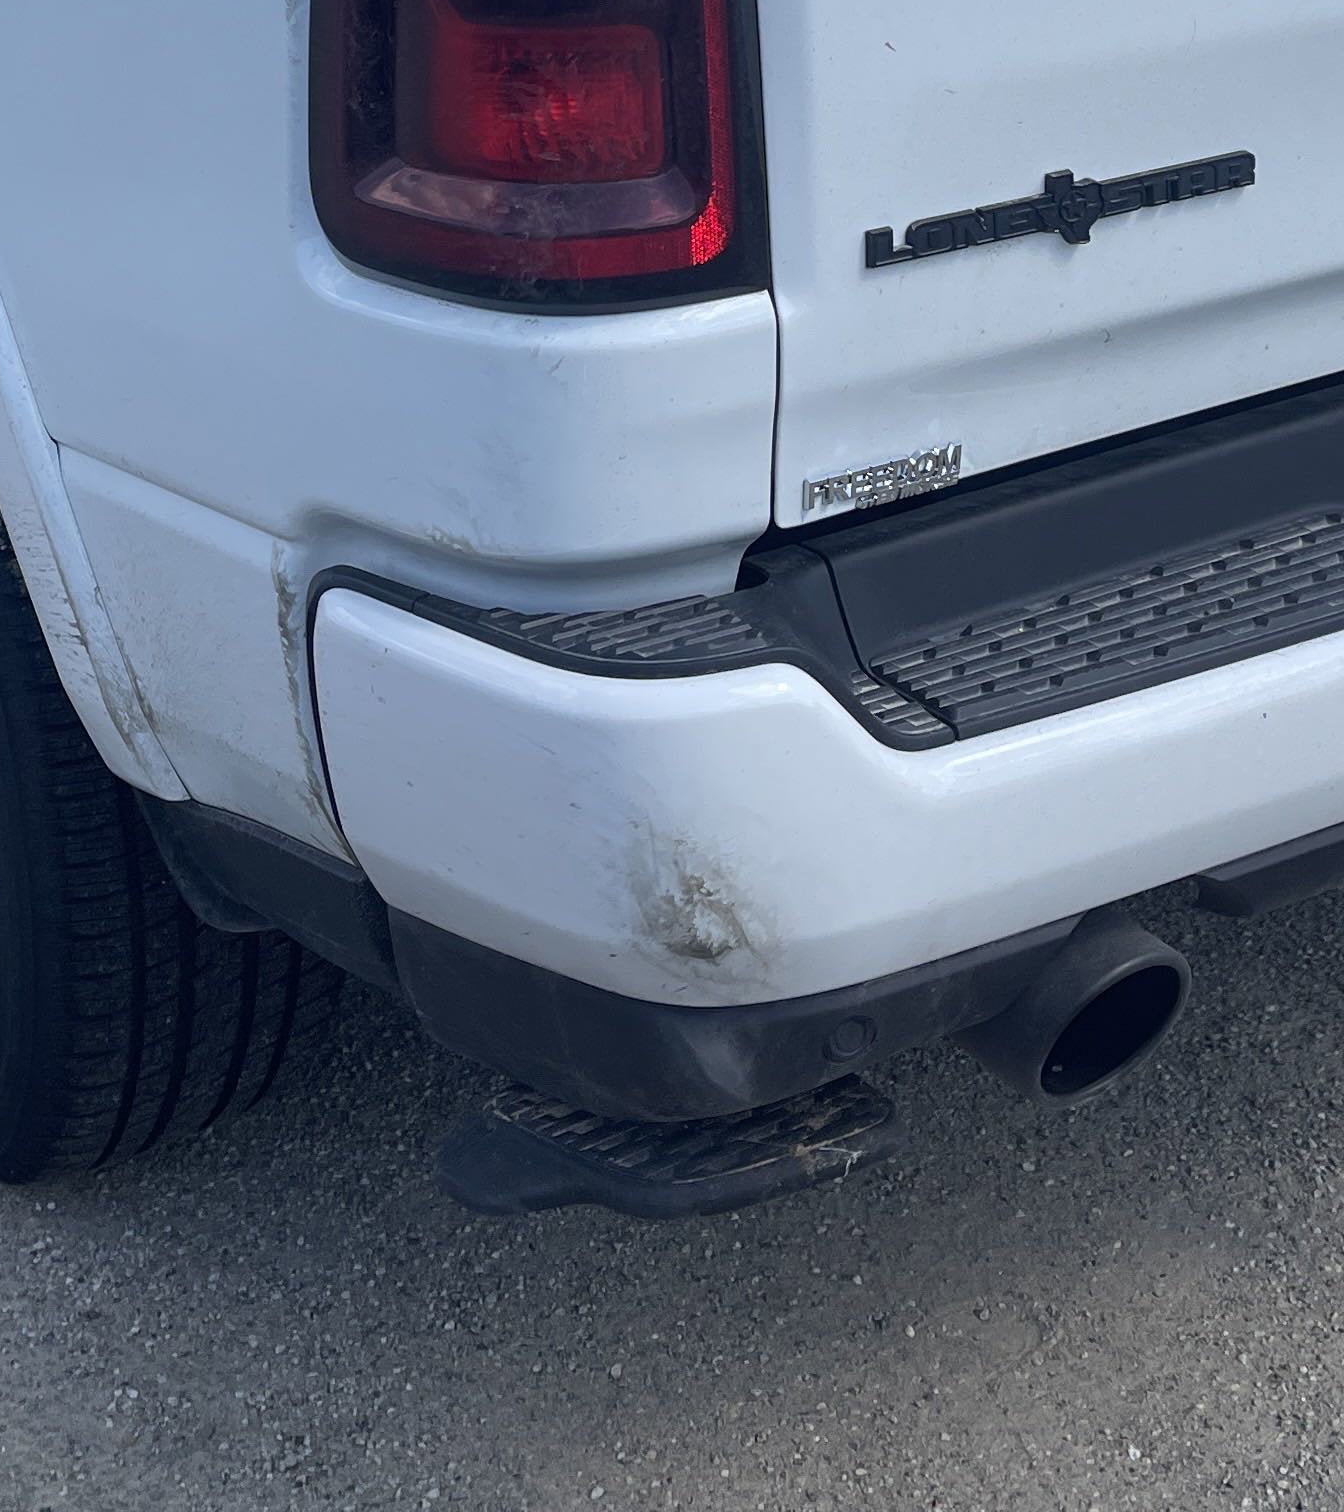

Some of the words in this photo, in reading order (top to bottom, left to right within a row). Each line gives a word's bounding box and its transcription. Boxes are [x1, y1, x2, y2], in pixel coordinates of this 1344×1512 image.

[864, 194, 1047, 268] LONE
[1102, 149, 1256, 219] STAR
[802, 443, 962, 510] FREEDOM
